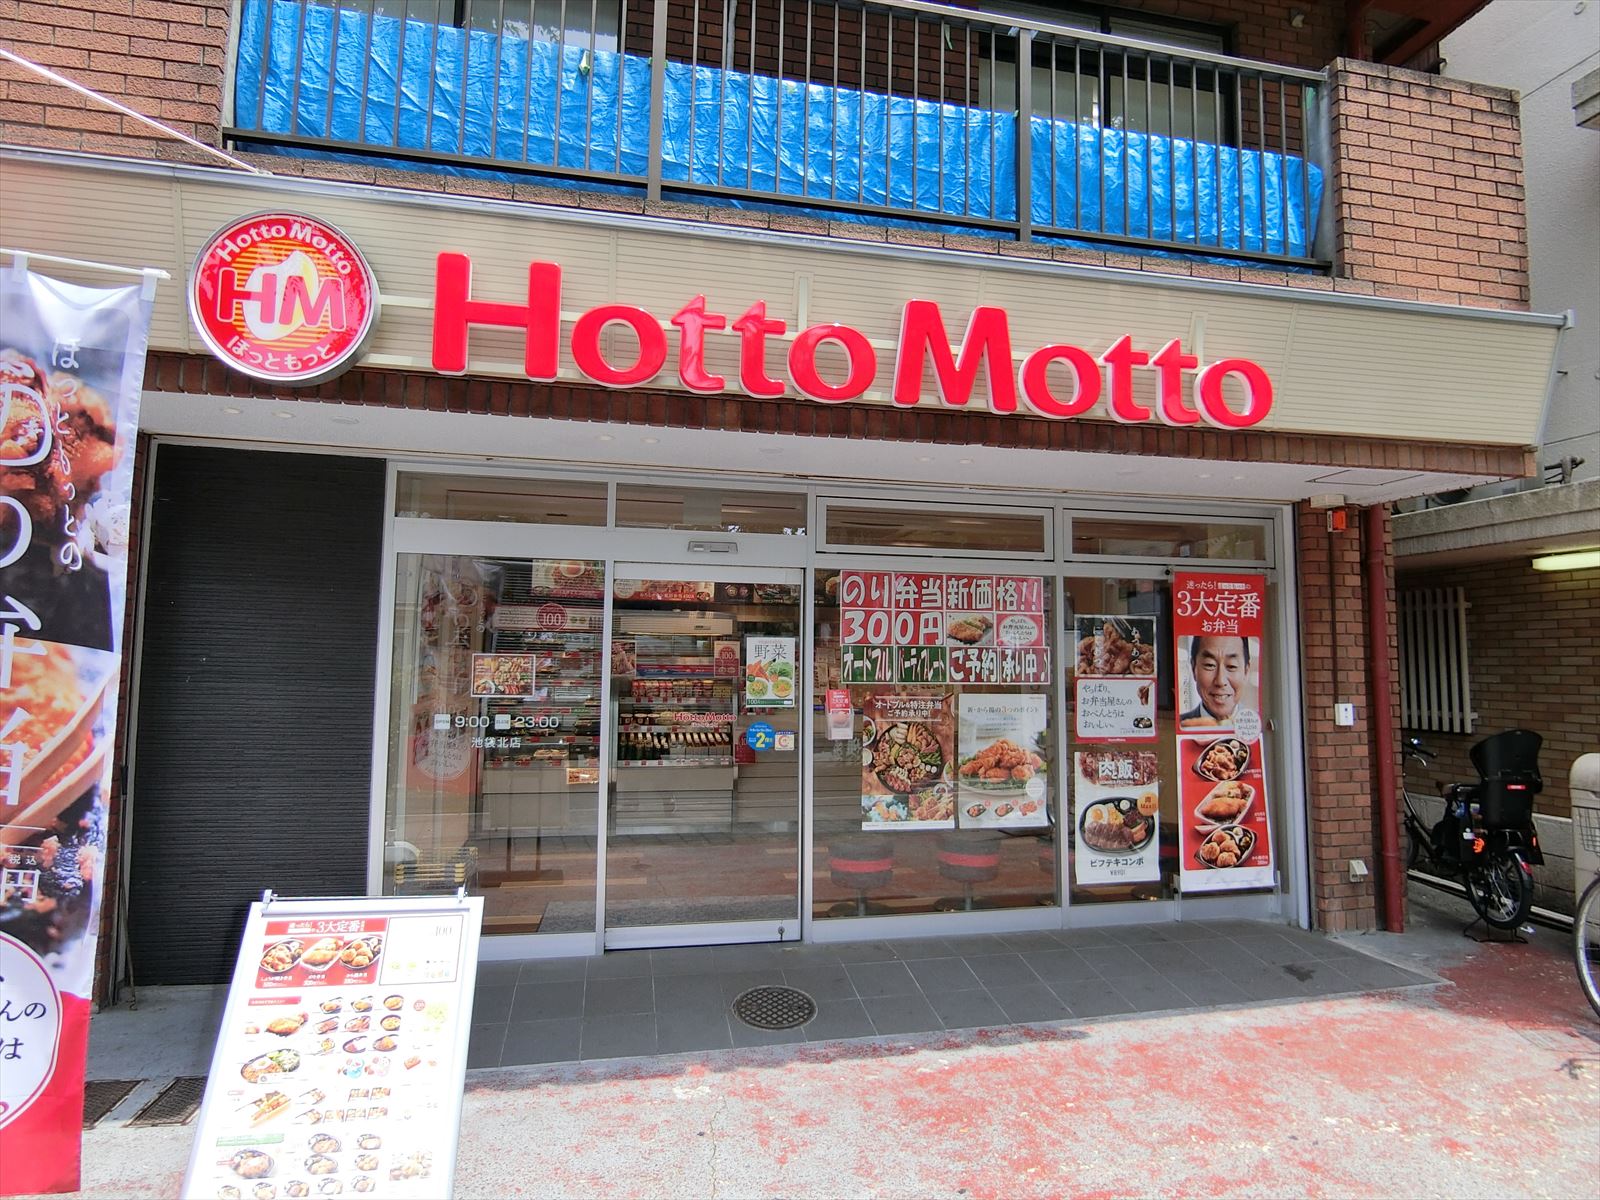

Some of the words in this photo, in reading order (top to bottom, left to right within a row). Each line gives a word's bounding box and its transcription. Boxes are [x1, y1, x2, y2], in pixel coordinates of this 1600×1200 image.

[215, 225, 286, 262] Hotto
[289, 223, 352, 275] Motto
[216, 266, 347, 332] HM
[432, 250, 877, 403] Hotto
[892, 298, 1273, 430] Motto
[226, 335, 336, 371] ほっともっと
[1176, 591, 1261, 619] 3大定番
[843, 610, 944, 645] 300円
[1201, 618, 1239, 634] お弁当
[754, 643, 788, 660] 野菜
[455, 716, 490, 728] 9:00
[514, 716, 560, 729] 23:00
[471, 736, 522, 749] 池袋北店
[8, 854, 37, 866] 税込
[1090, 856, 1144, 868] ビフテキコンボ
